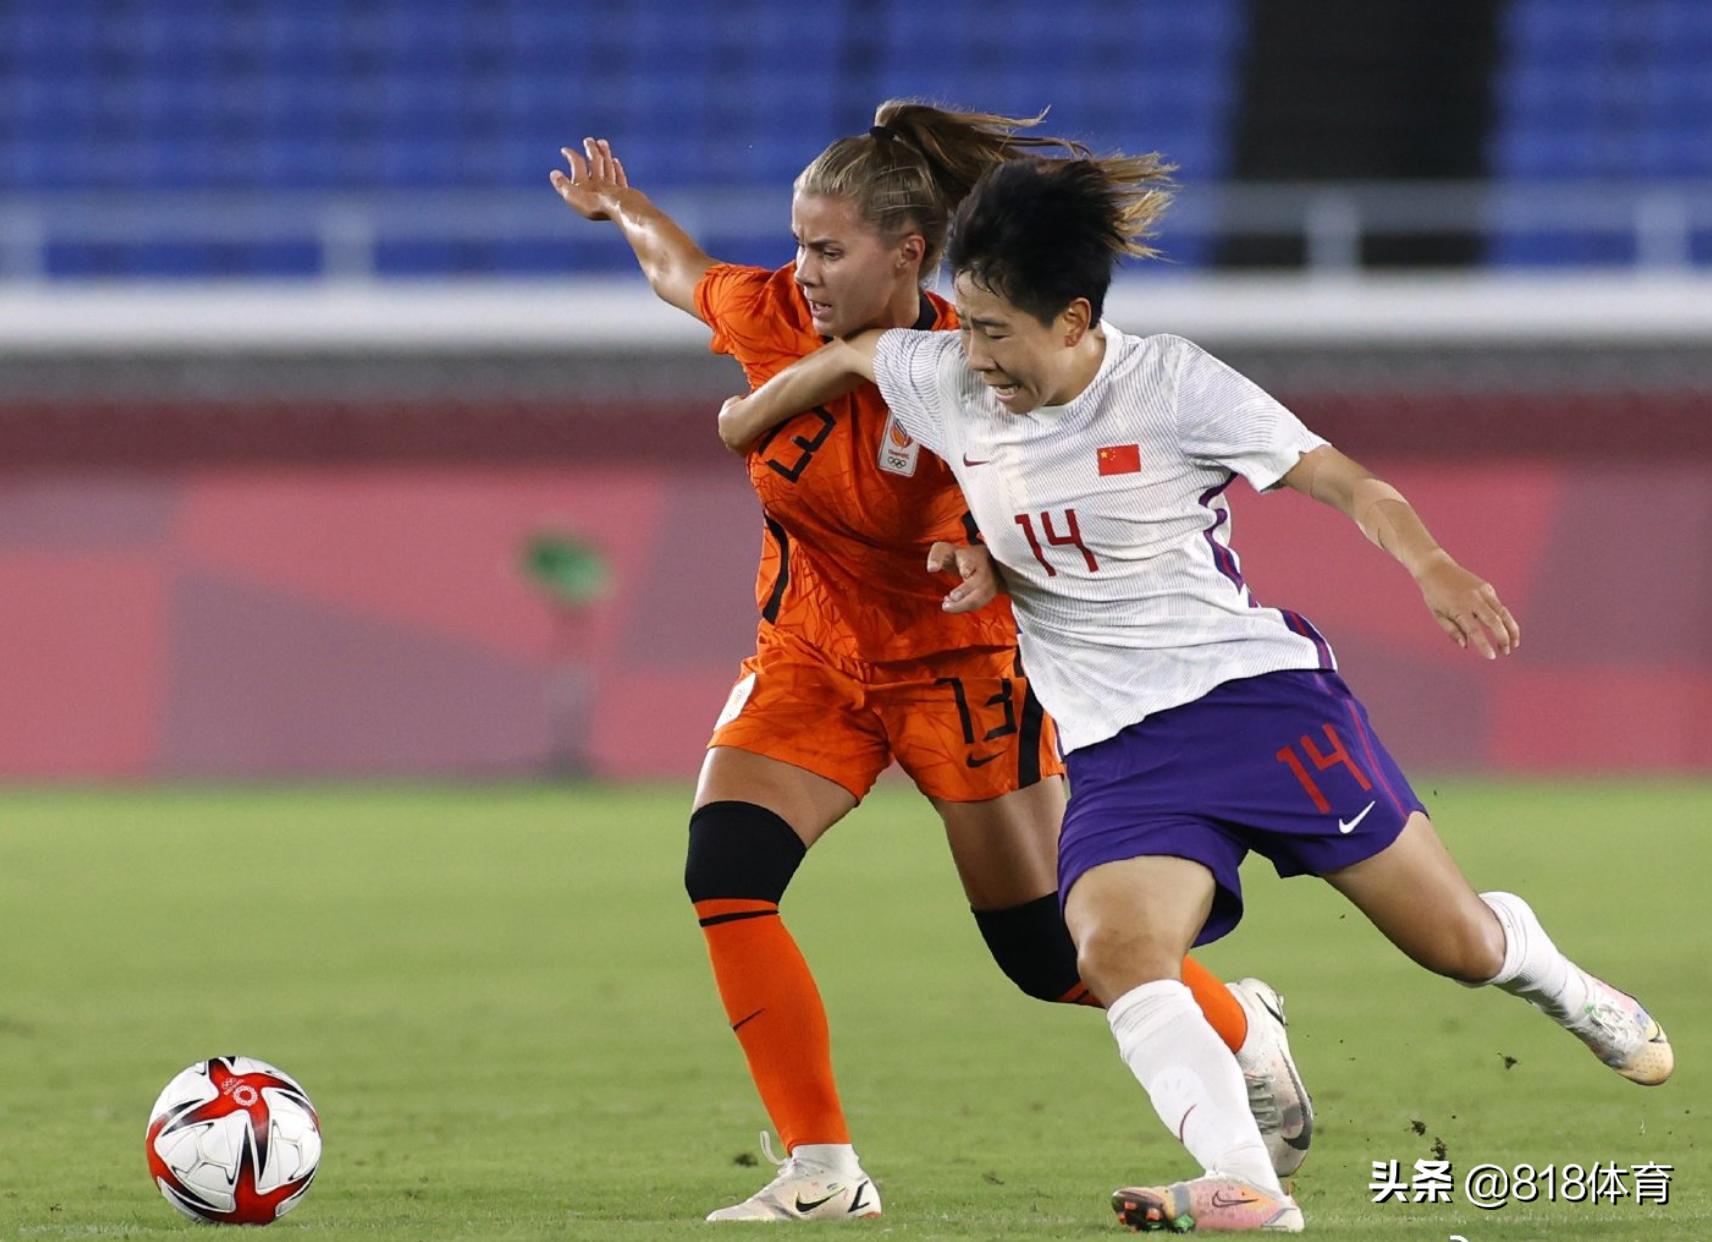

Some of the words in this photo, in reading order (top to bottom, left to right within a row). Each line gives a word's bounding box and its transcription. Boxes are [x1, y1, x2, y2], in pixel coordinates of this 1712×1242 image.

[1014, 508, 1099, 577] 14
[934, 677, 1017, 745] 13
[1275, 722, 1373, 814] 14
